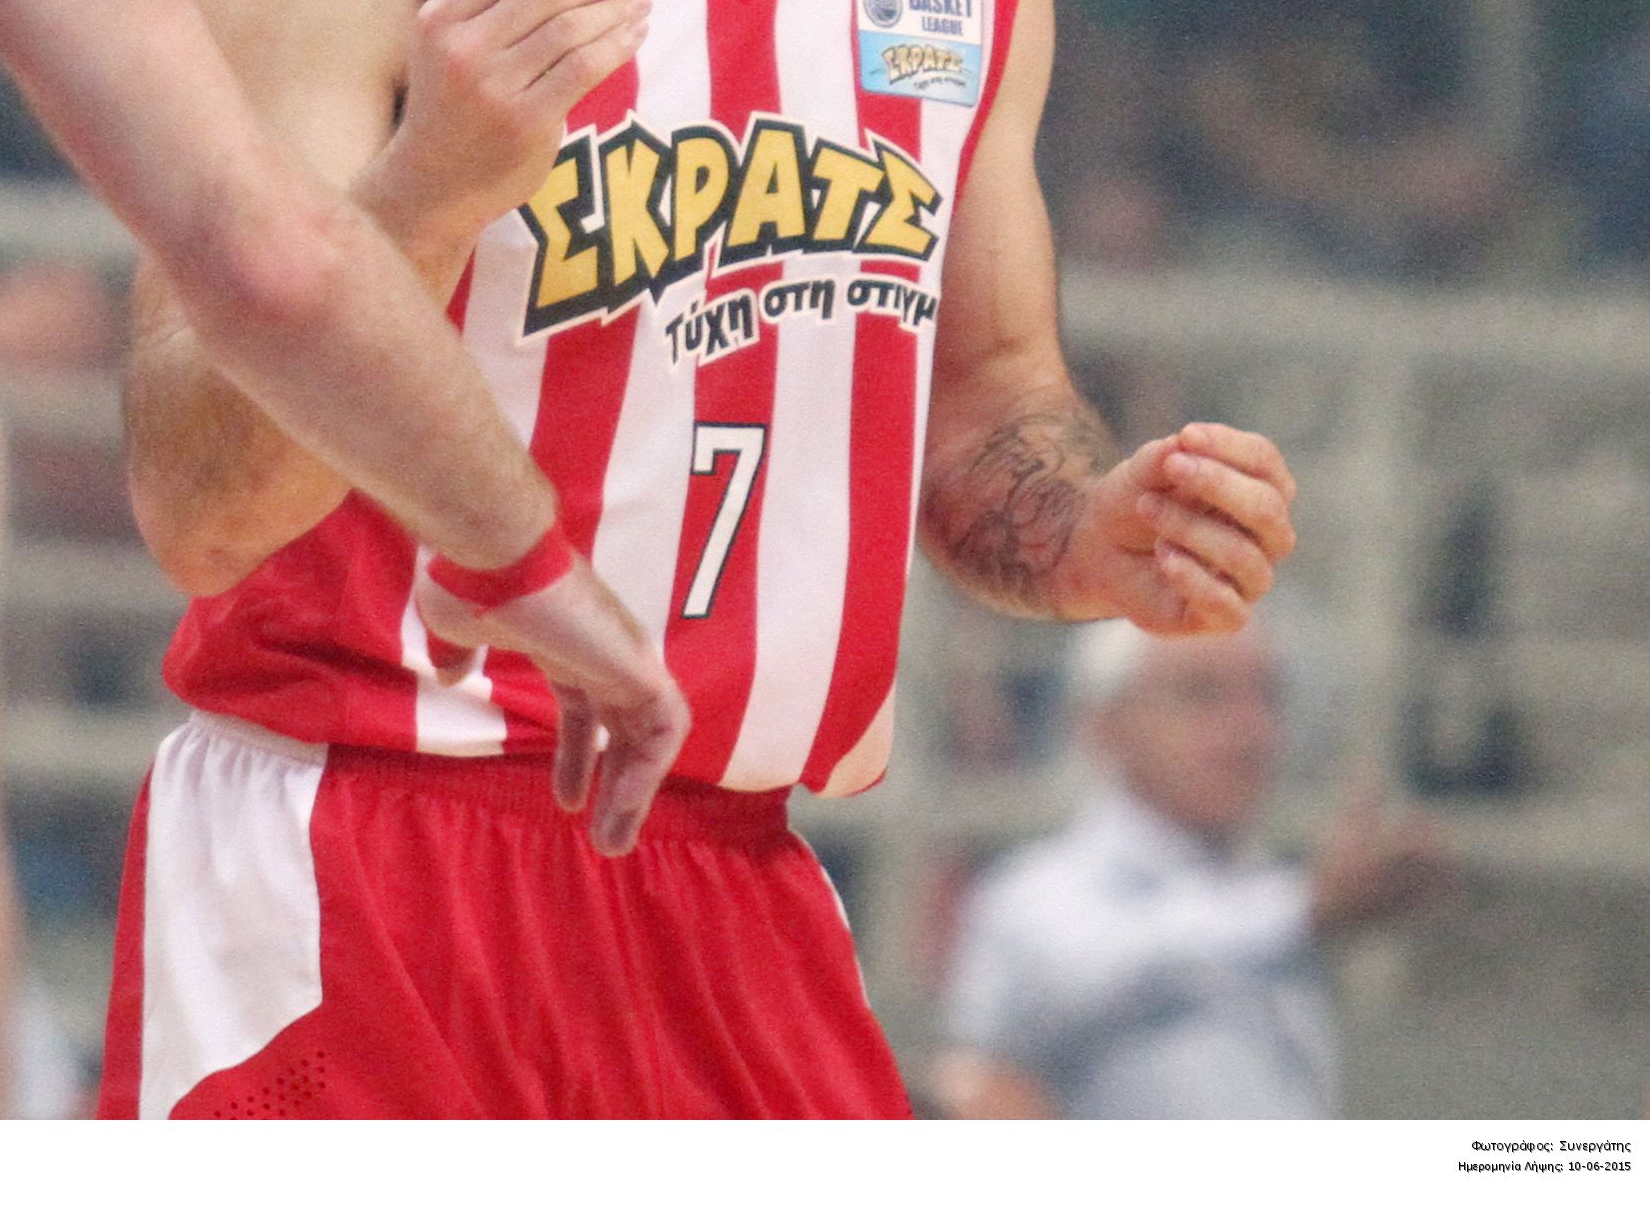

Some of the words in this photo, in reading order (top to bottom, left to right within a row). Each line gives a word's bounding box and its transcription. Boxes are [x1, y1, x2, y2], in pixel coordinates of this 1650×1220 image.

[921, 16, 964, 37] LEAGUE
[516, 117, 942, 337] ΣΚΡΑΤΣ
[764, 279, 836, 320] στη
[681, 421, 767, 620] 7
